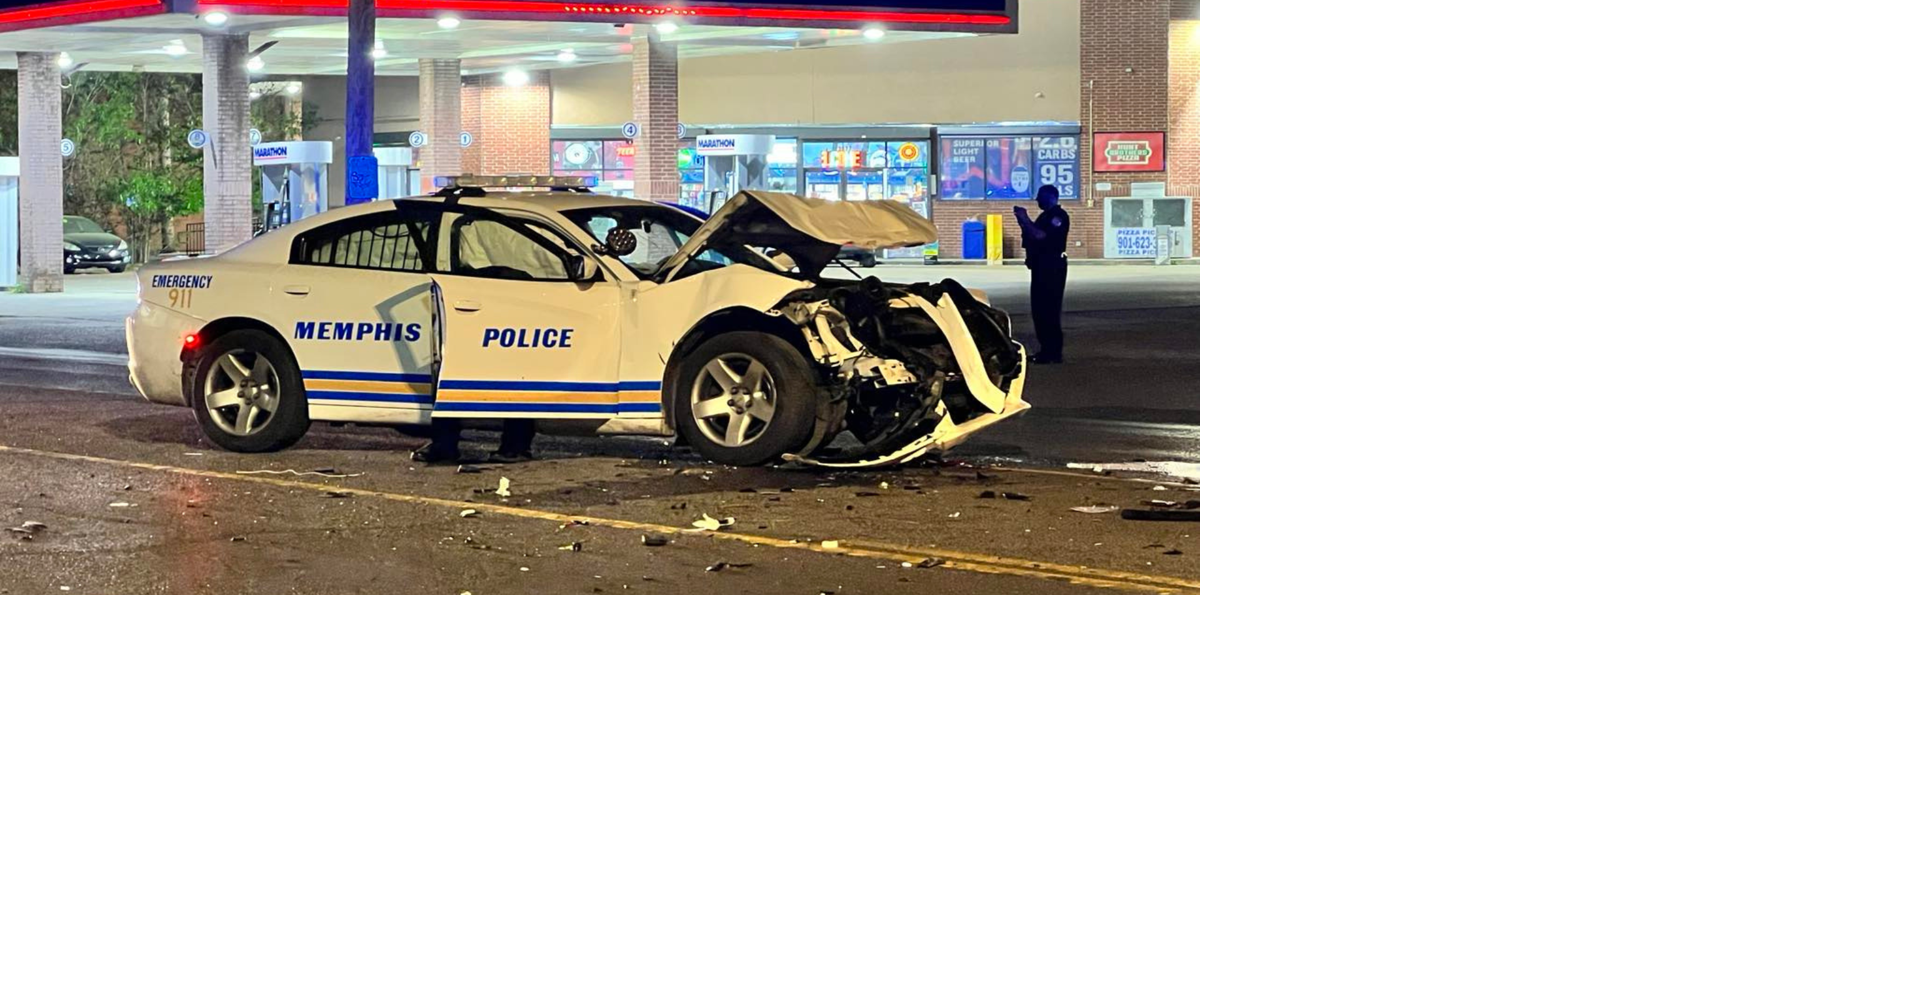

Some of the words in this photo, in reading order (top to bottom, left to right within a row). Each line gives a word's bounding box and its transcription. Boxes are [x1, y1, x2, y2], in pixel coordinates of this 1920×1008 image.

[627, 126, 633, 134] 4
[698, 139, 735, 148] MARATHON
[254, 146, 287, 157] MARATHON
[1038, 149, 1076, 160] CARBS
[1040, 164, 1074, 185] 95
[152, 274, 213, 289] EMERGENCY
[168, 288, 193, 309] 911
[293, 321, 422, 342] MEMPHIS
[482, 328, 574, 348] POLICE
